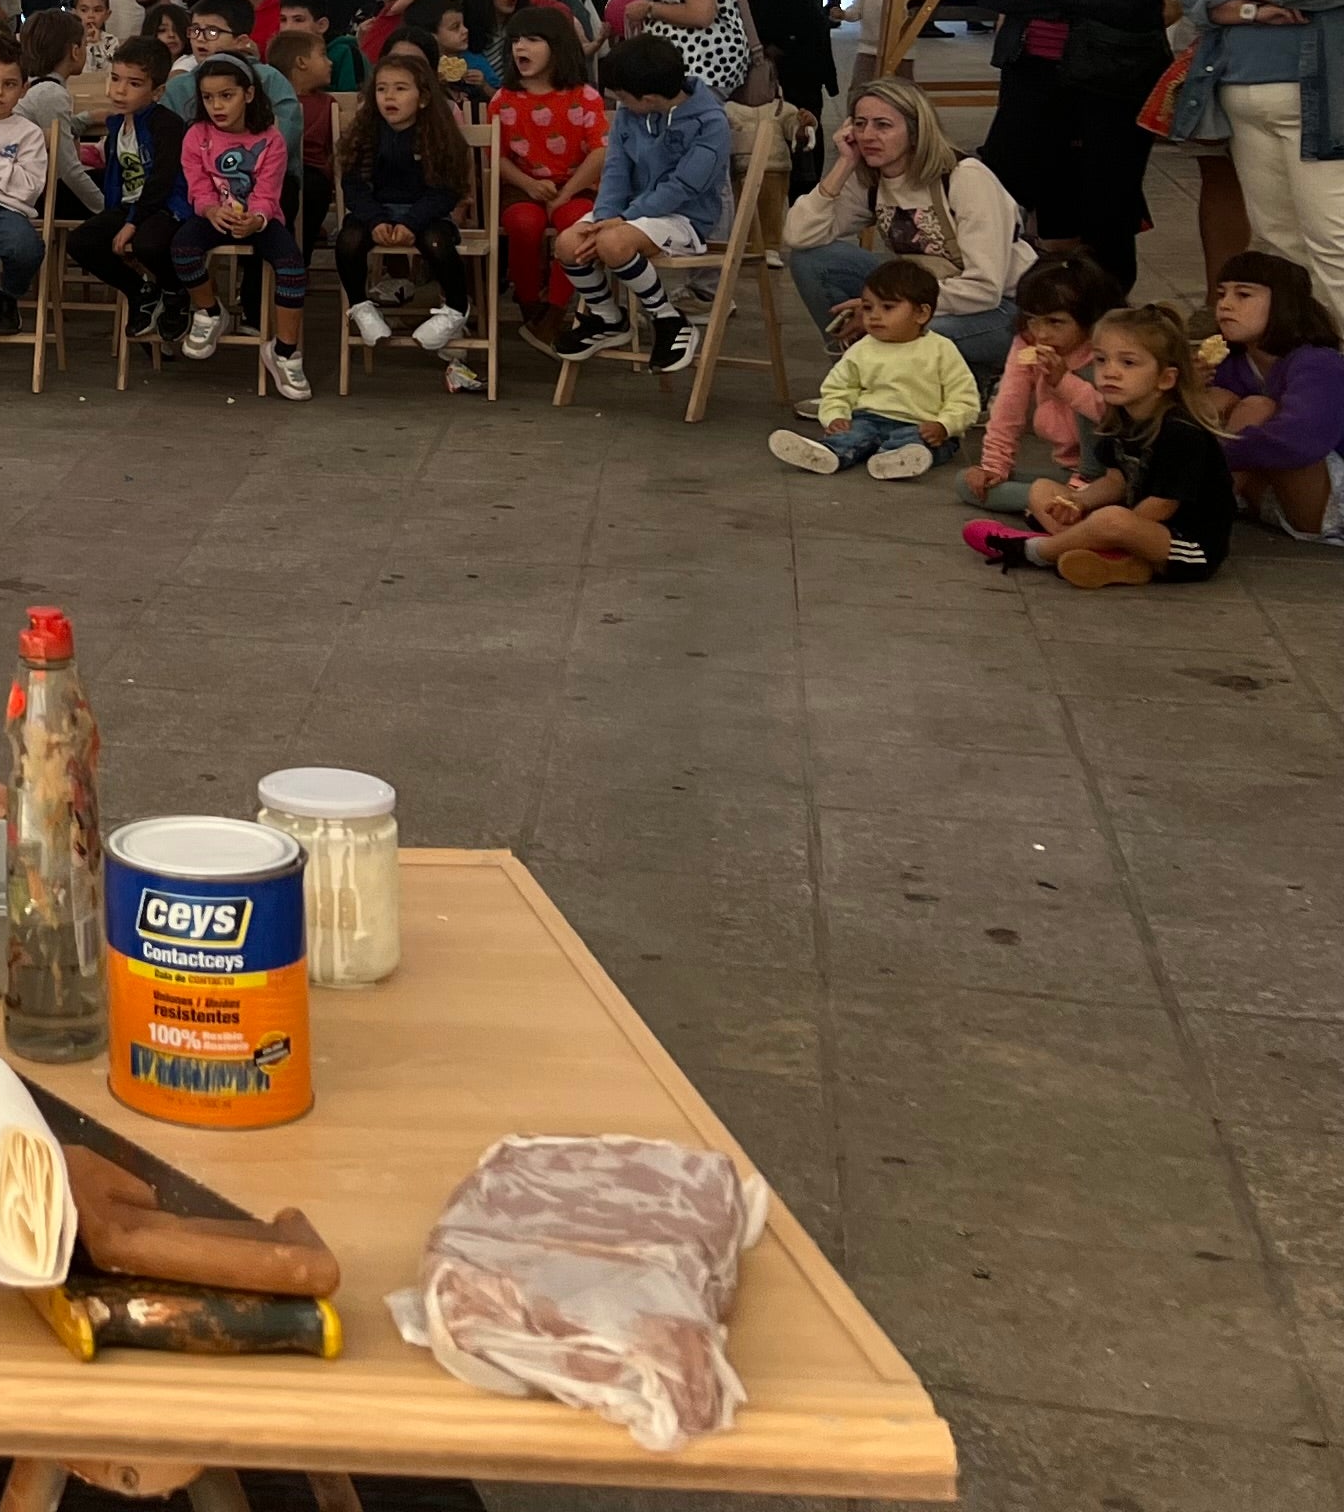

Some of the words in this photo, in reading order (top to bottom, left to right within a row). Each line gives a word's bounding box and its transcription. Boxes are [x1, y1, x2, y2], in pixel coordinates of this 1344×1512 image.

[146, 898, 237, 938] ceys
[142, 941, 244, 973] Contactceys
[153, 1004, 240, 1025] resistentes
[148, 1022, 201, 1051] 100%
